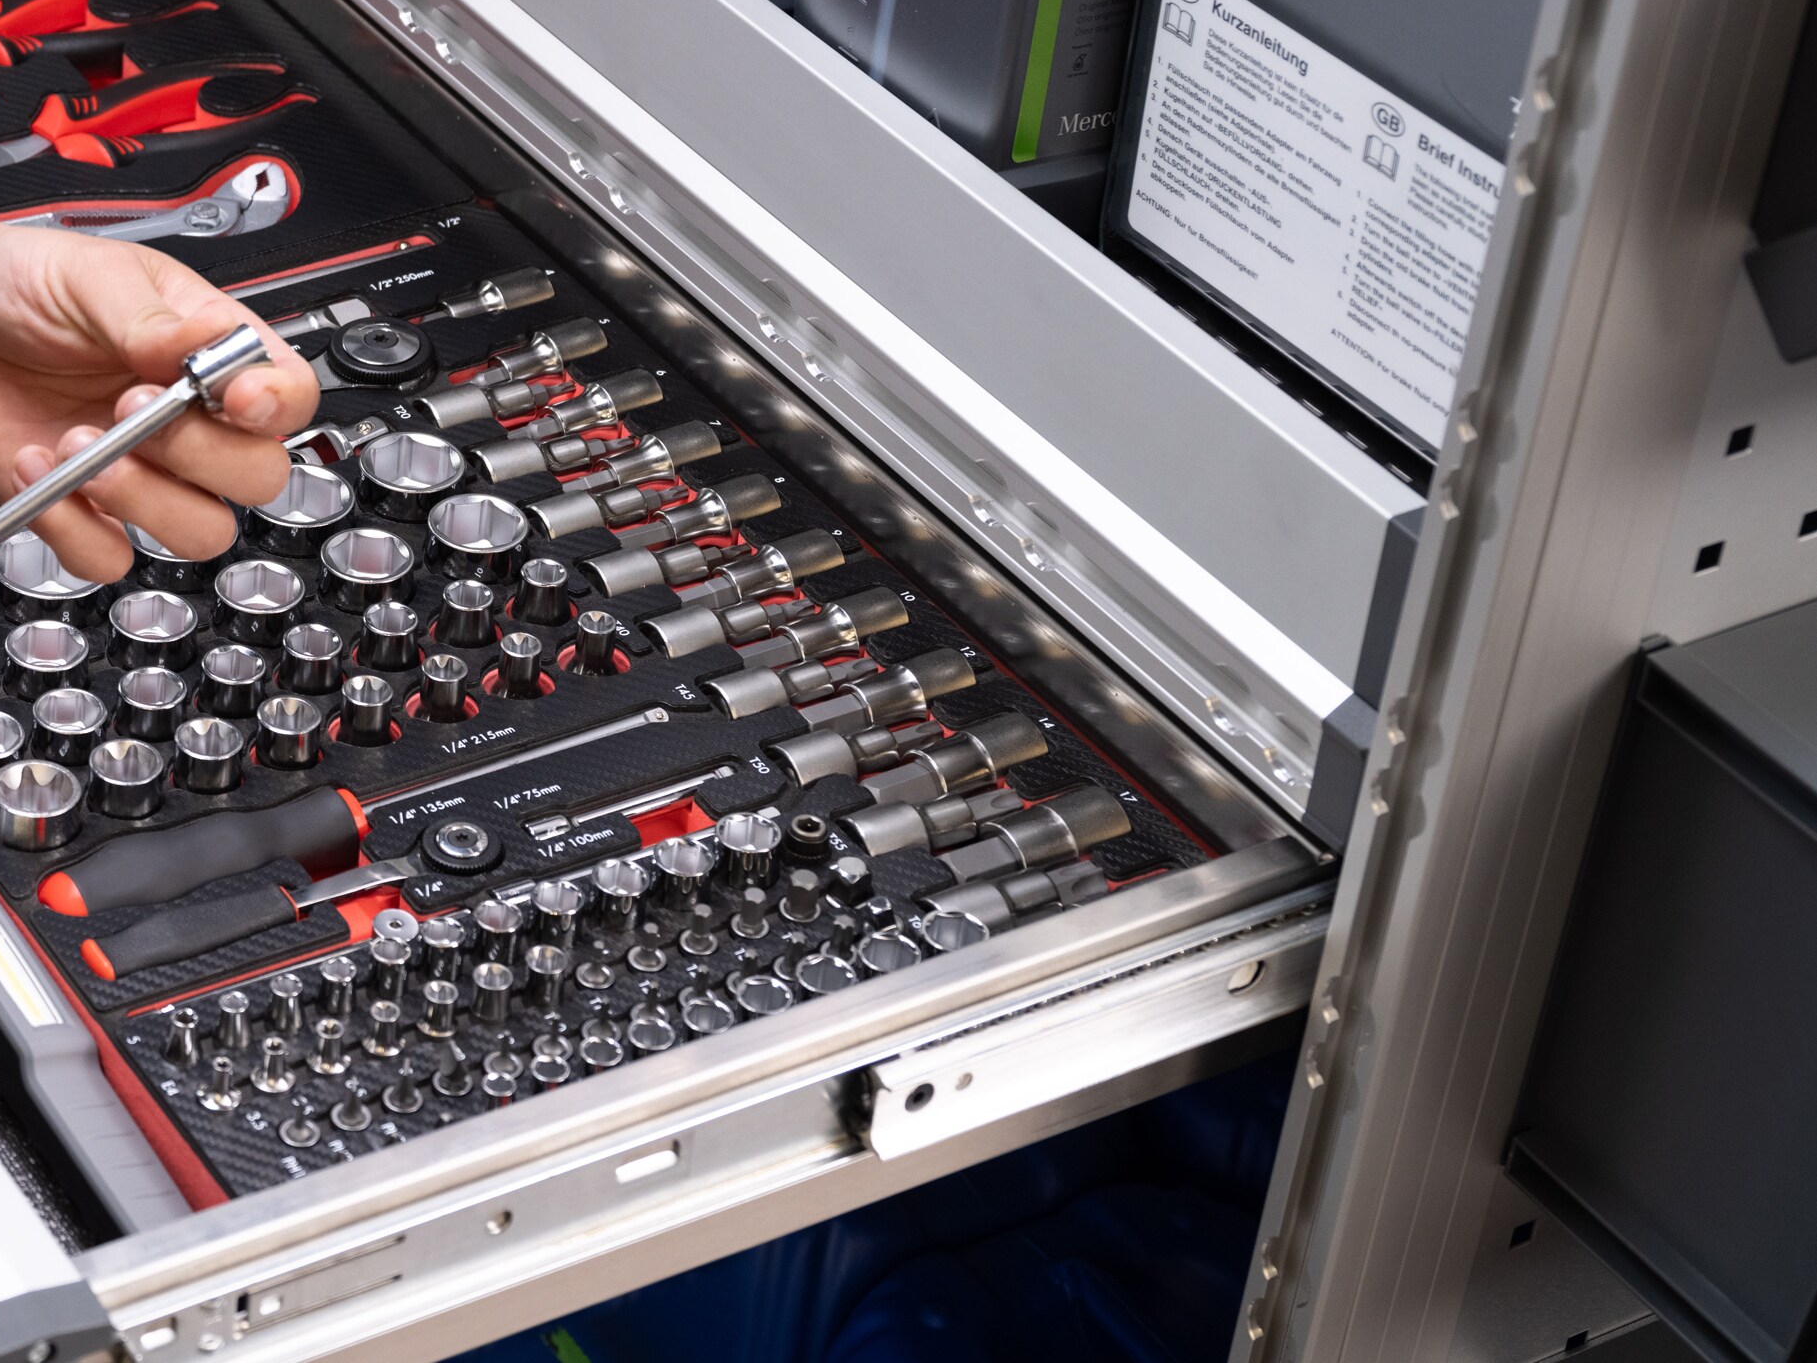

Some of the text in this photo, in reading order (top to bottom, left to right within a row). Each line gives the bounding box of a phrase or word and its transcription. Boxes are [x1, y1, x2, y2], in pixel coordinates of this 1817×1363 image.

[1163, 85, 1200, 118] Kugelhahn
[1167, 62, 1210, 99] Füllschlauch
[1224, 101, 1264, 135] passendem
[1266, 129, 1293, 155] Adapter
[1307, 157, 1342, 188] Fahrzeug
[1376, 105, 1401, 134] GB
[1155, 135, 1191, 167] Kugelhahn
[1157, 122, 1183, 146] Danach
[1204, 155, 1245, 190] ausschalten
[1417, 132, 1455, 169] Brief
[1151, 158, 1165, 175] Den
[1267, 240, 1294, 267] Adapter
[395, 269, 435, 285] 250mm
[393, 404, 412, 420] T20
[900, 590, 916, 602] 10
[960, 646, 976, 658] 12
[674, 683, 696, 701] T45
[1038, 717, 1055, 729] 14
[441, 725, 516, 754] 1/4" 215mm
[749, 756, 771, 775] T50
[389, 795, 466, 825] 1/4" 135mm
[493, 784, 561, 810] 1/4" 75mm
[1119, 791, 1138, 803] 17
[538, 828, 614, 858] 1/4" 100mm
[415, 880, 444, 897] 1/4"
